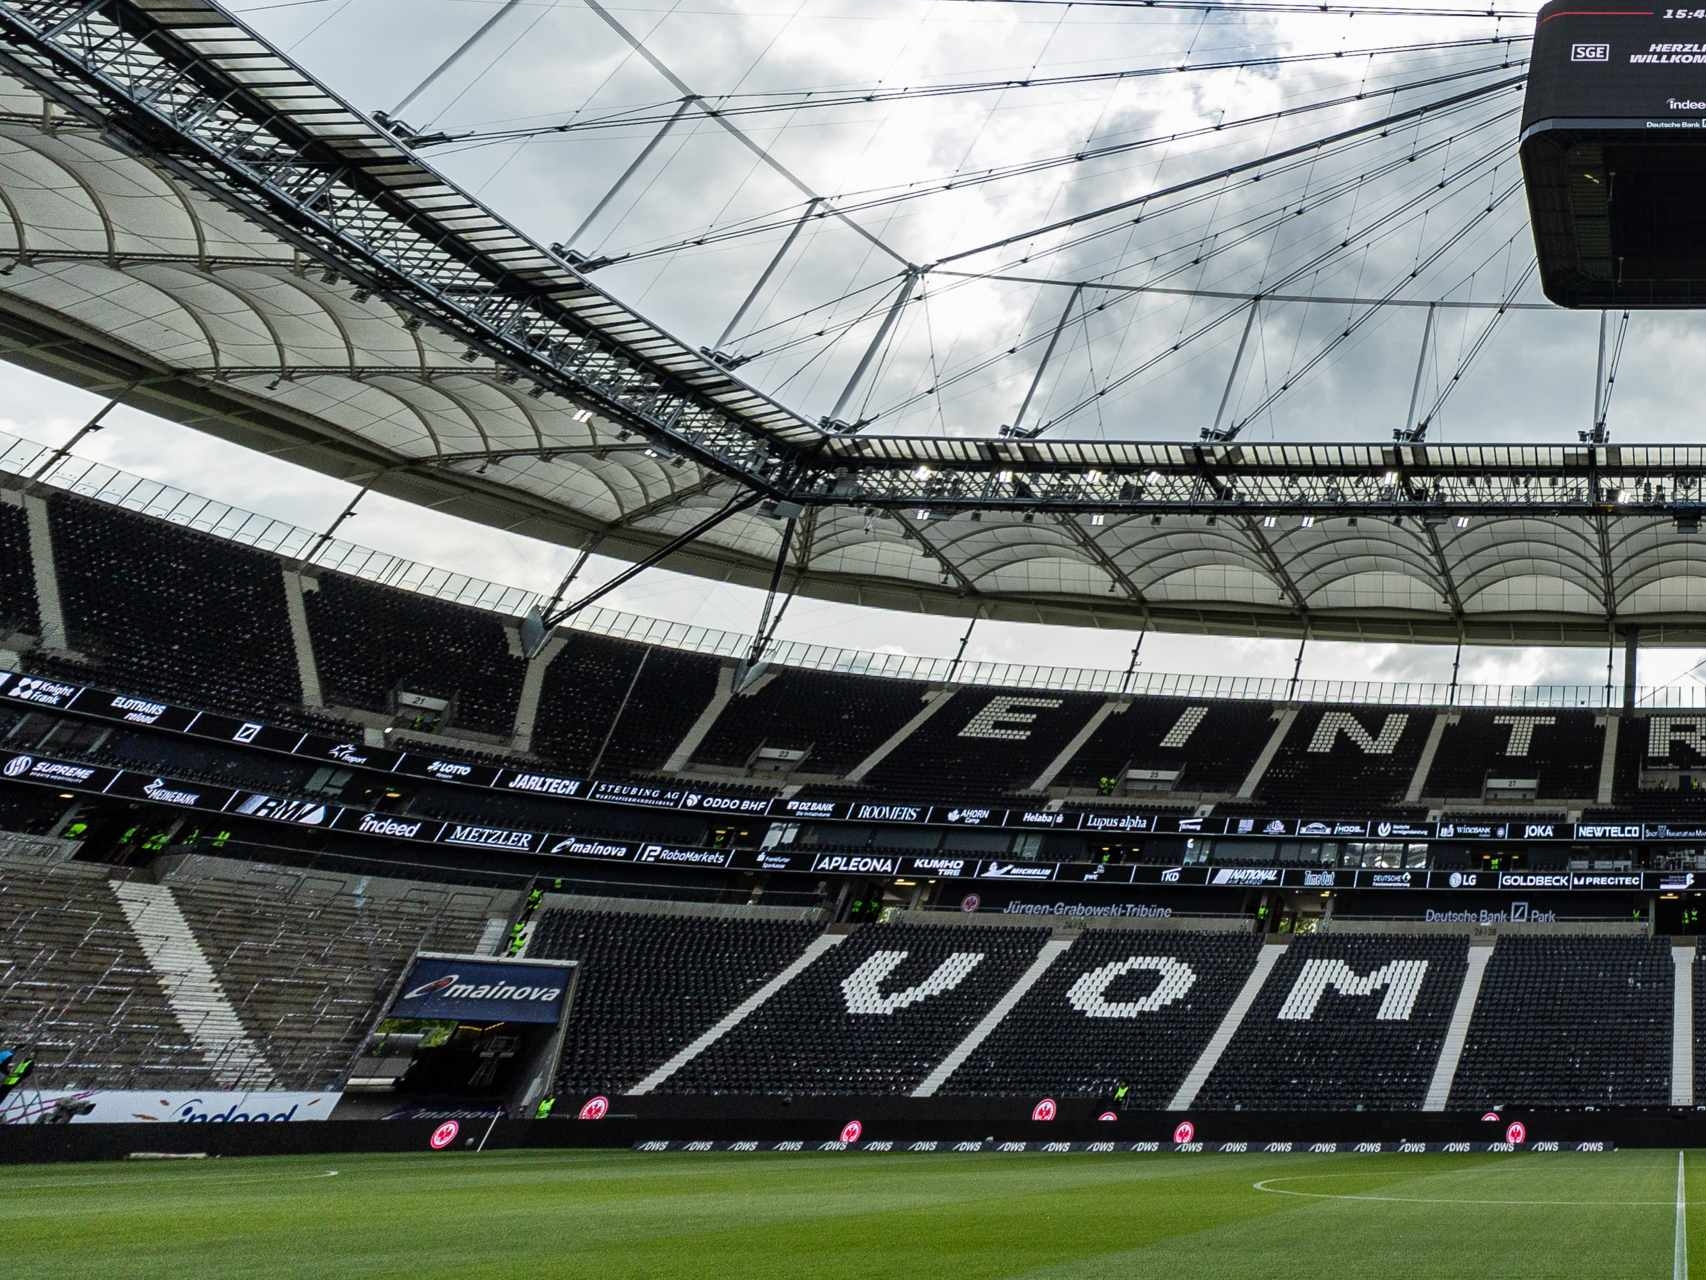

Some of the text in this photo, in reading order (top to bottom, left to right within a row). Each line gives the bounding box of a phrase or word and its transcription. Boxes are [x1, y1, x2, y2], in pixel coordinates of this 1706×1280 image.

[1576, 46, 1605, 60] SGE
[1646, 121, 1681, 129] Deutsche
[1682, 121, 1701, 129] Bank
[40, 681, 74, 697] Knight
[29, 690, 60, 705] Frank
[110, 696, 167, 716] ELOTRANS
[31, 761, 96, 780] SUPREME
[439, 762, 472, 776] LOTTO
[508, 773, 580, 795] JARLTECH
[598, 783, 681, 801] STEUBING AG
[702, 797, 768, 813] ODDO BHF
[798, 801, 836, 812] DZ BANK
[858, 805, 918, 821] ROOMERS
[960, 809, 990, 819] AHORN
[1022, 812, 1053, 823] Helaba
[359, 813, 422, 838] indeed
[1086, 814, 1147, 831] Lupus alpha
[450, 825, 533, 848] METZLER
[1524, 825, 1553, 839] JOKA
[1578, 826, 1640, 838] NEWTELCO
[569, 841, 627, 858] mainova
[659, 850, 725, 864] RoboMarkets
[817, 856, 893, 873] APLEONA
[914, 859, 964, 870] KUMHO
[937, 868, 961, 877] TIRE
[1010, 868, 1052, 876] MICHELIN
[1229, 869, 1277, 880] NATIONAL
[1462, 874, 1477, 886] LG
[1502, 875, 1569, 887] GOLDBECK
[1586, 876, 1640, 886] PRECITEC
[1003, 900, 1173, 918] Jürgen-Grabowski-Tribüne
[1425, 908, 1556, 923] Deutsche Bank Park
[443, 980, 562, 1002] mainova
[840, 951, 1430, 1020] VOM
[646, 1141, 1603, 1152] DWS DWS DWS DWS DWS DWS DWS DWS DWS DWS DWS DWS DWS DWS DWS
